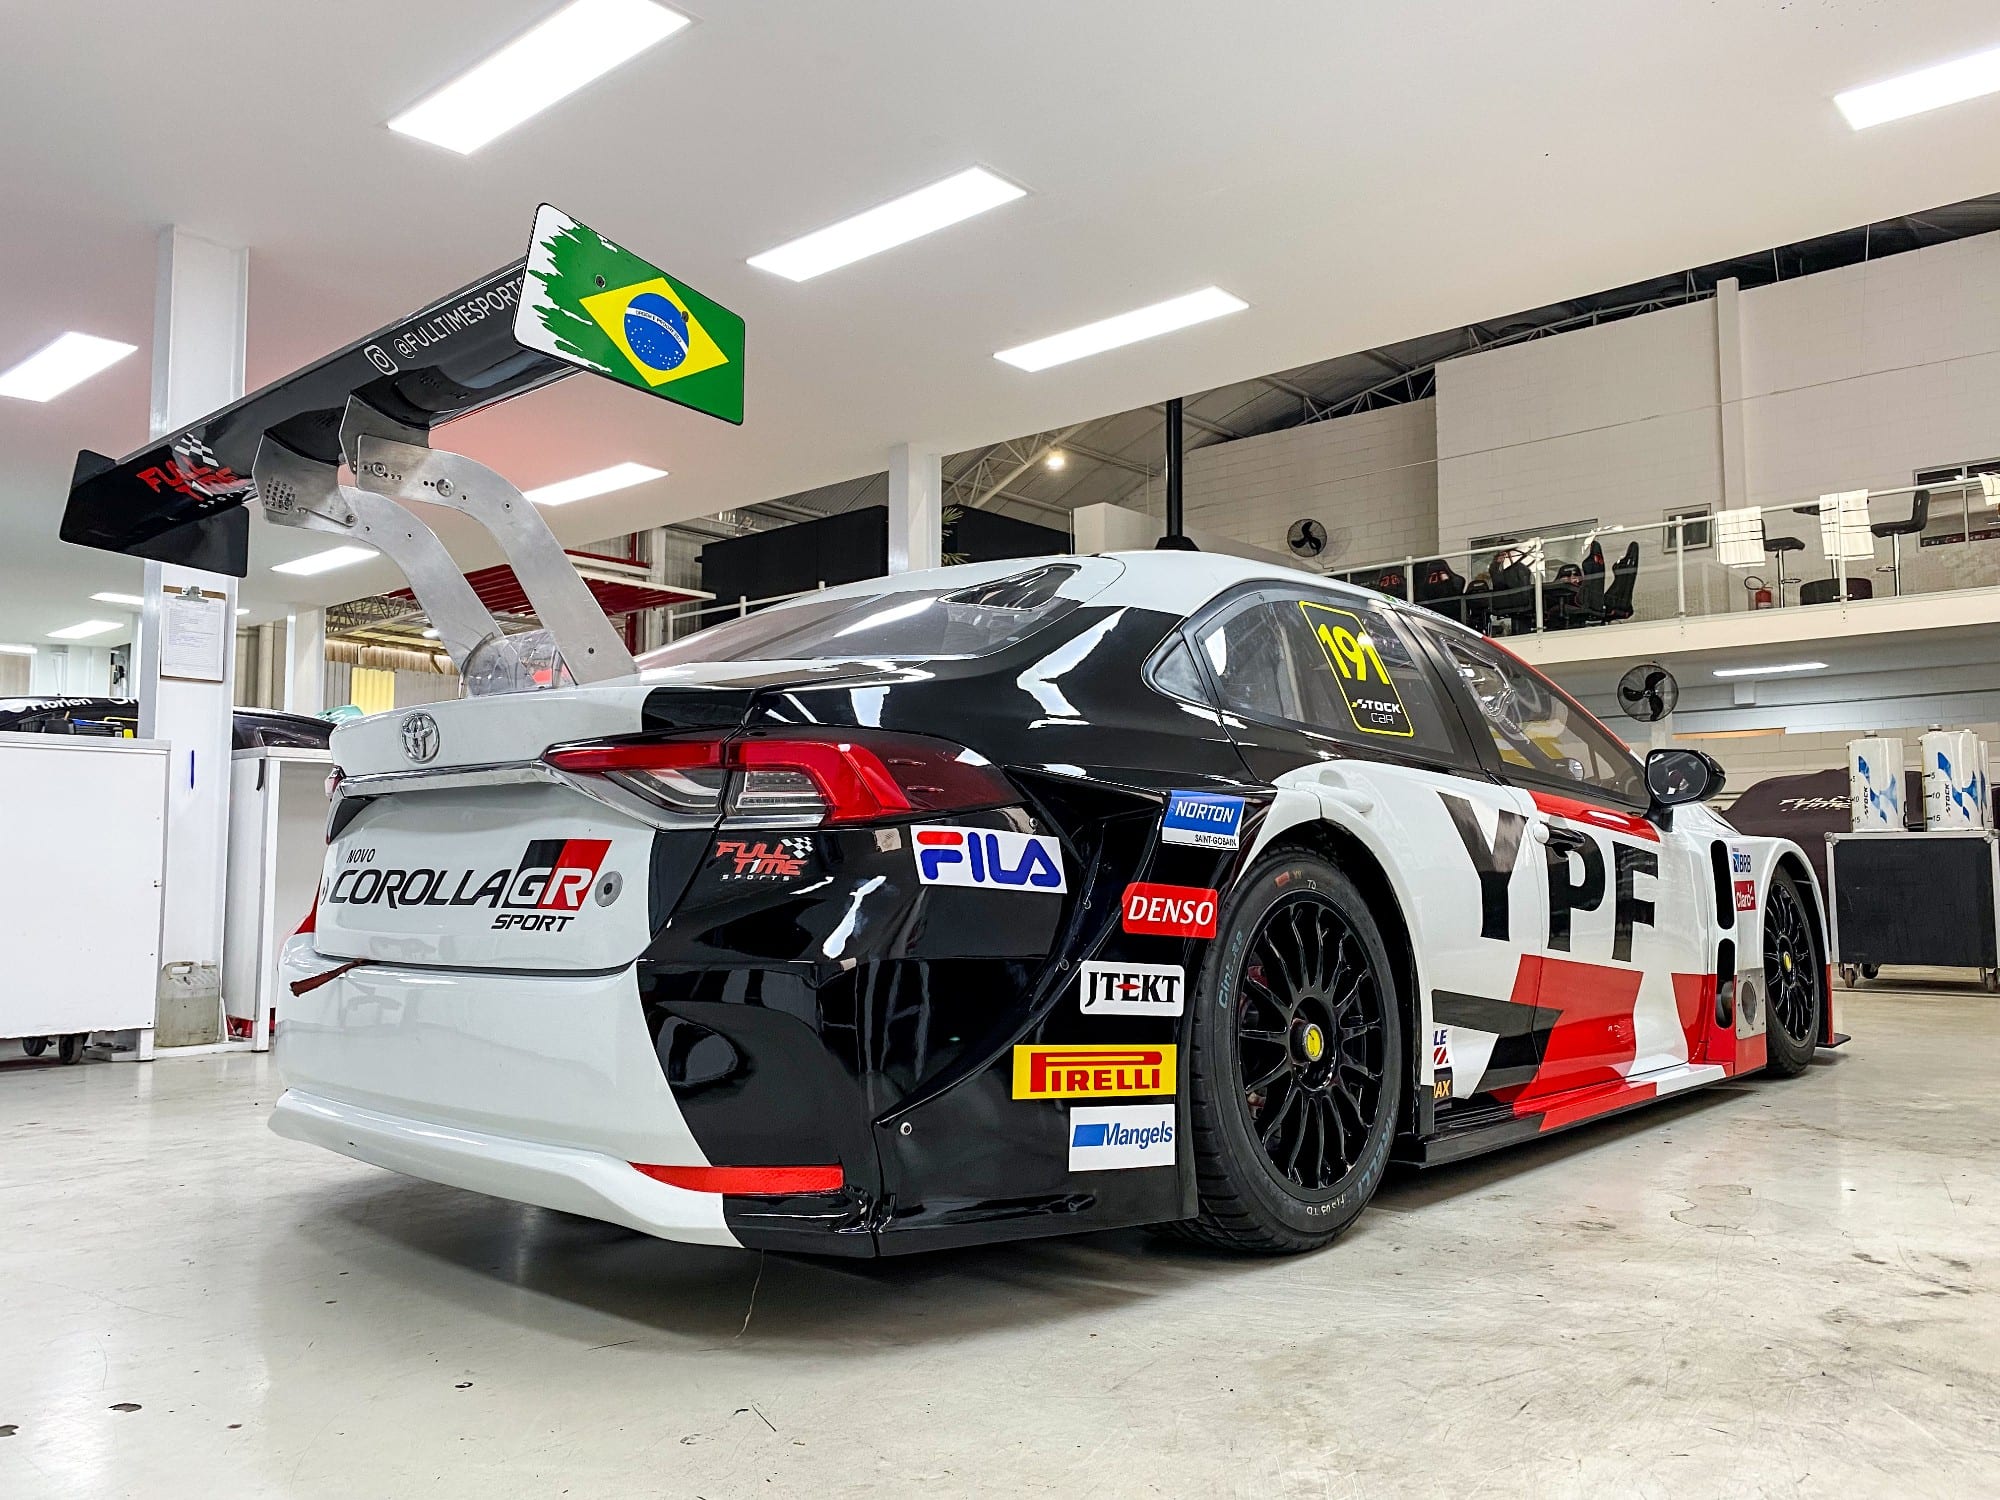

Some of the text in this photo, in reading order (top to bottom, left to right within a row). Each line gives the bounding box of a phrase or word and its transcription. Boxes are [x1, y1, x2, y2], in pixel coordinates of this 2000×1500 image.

[1318, 623, 1390, 685] 191
[1352, 699, 1401, 714] STOCK
[1175, 800, 1235, 823] NORTON
[716, 841, 791, 859] FULL
[1195, 834, 1237, 847] SAINT-GOBAIN
[347, 848, 376, 863] NOVO
[917, 831, 1062, 888] FILA
[329, 867, 594, 910] COROLLA GR
[1436, 791, 1659, 962] YPF
[491, 913, 575, 932] SPORT
[1128, 895, 1214, 926] DENSO
[1084, 971, 1181, 1008] JTEKT
[1030, 1051, 1162, 1093] PIRELLI
[1433, 1079, 1450, 1099] AX
[1101, 1120, 1173, 1149] Mangels
